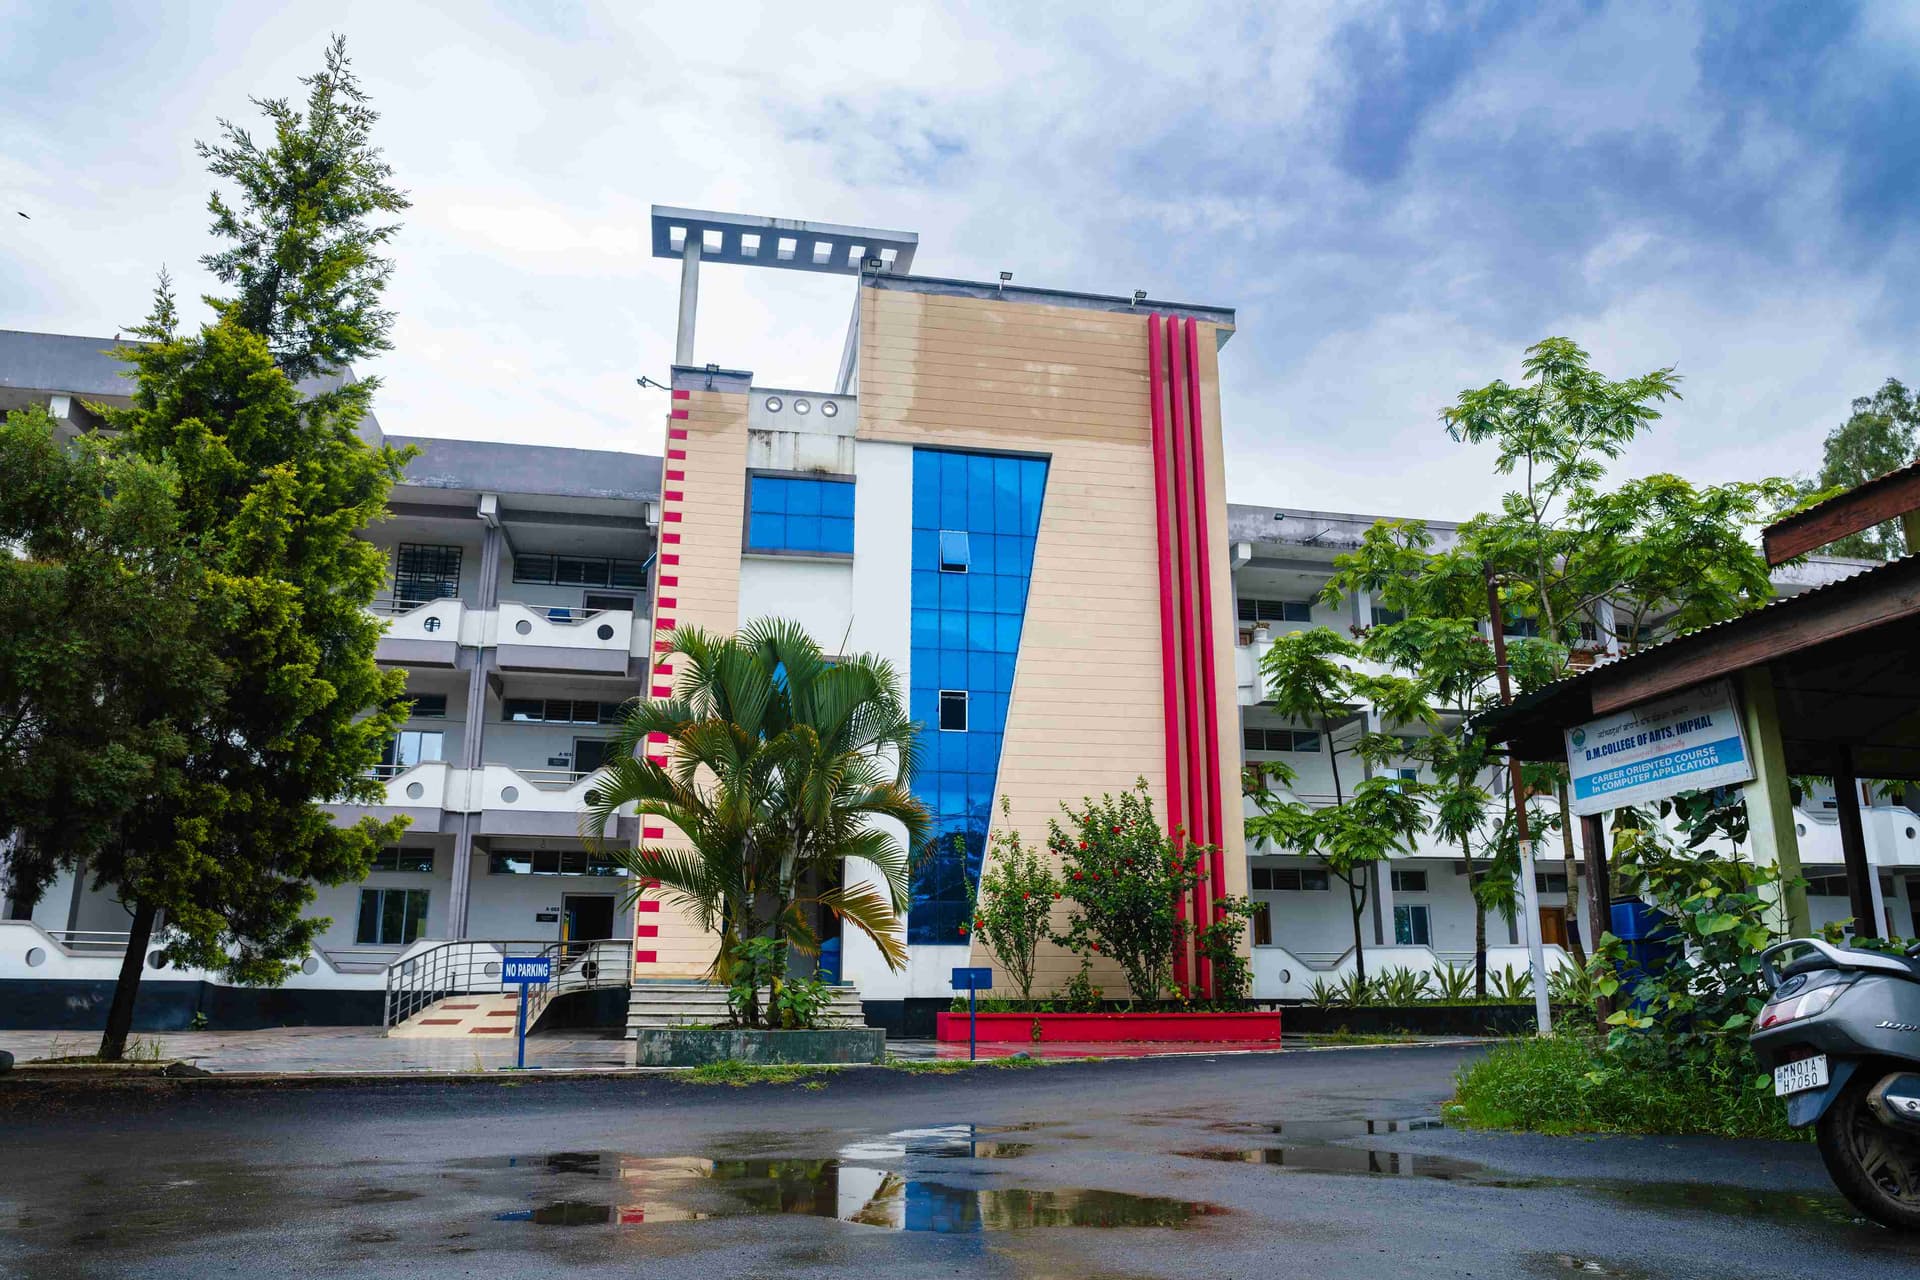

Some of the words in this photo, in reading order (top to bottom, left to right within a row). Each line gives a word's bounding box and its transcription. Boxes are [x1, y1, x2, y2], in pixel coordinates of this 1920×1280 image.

[1637, 734, 1647, 746] OF
[1676, 714, 1713, 736] IMPHAL
[1591, 770, 1625, 785] CAREER
[1625, 758, 1673, 778] ORIENTED
[1674, 746, 1717, 764] COURSE
[1591, 785, 1601, 794] In
[1601, 771, 1650, 792] COMPUTER
[1652, 755, 1719, 779] APPLICATION
[505, 963, 517, 977] NO
[517, 963, 548, 977] PARKING
[1783, 1058, 1817, 1079] MN01A
